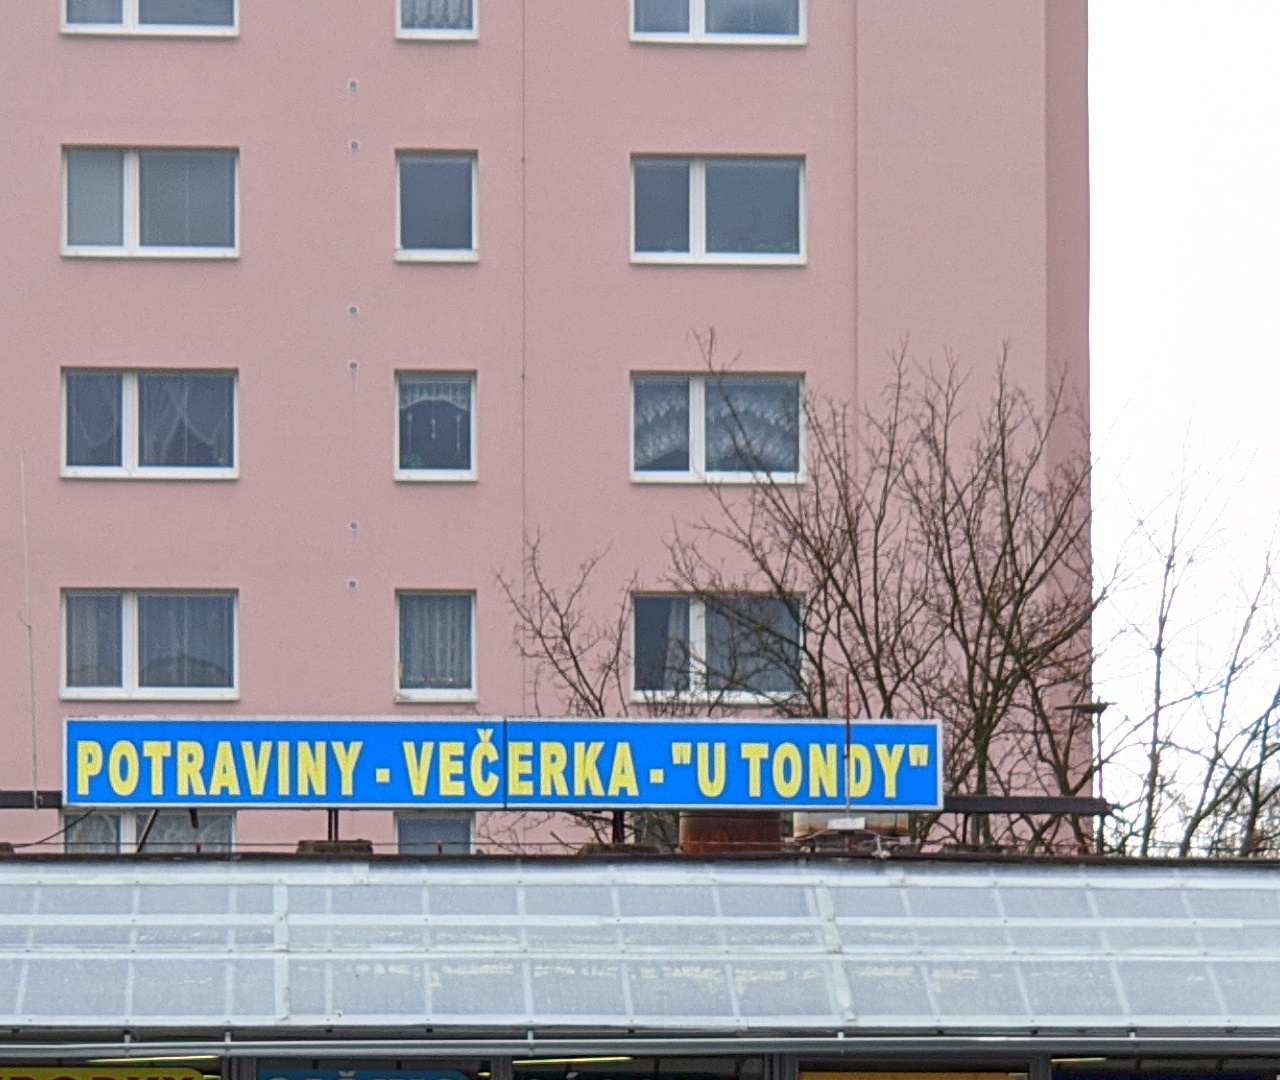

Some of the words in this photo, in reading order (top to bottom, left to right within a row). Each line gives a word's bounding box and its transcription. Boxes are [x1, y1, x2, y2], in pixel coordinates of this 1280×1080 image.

[77, 741, 363, 796] POTRAVINY
[404, 731, 639, 797] VEČERKA
[672, 744, 726, 797] "U
[742, 744, 929, 798] TONDY"
